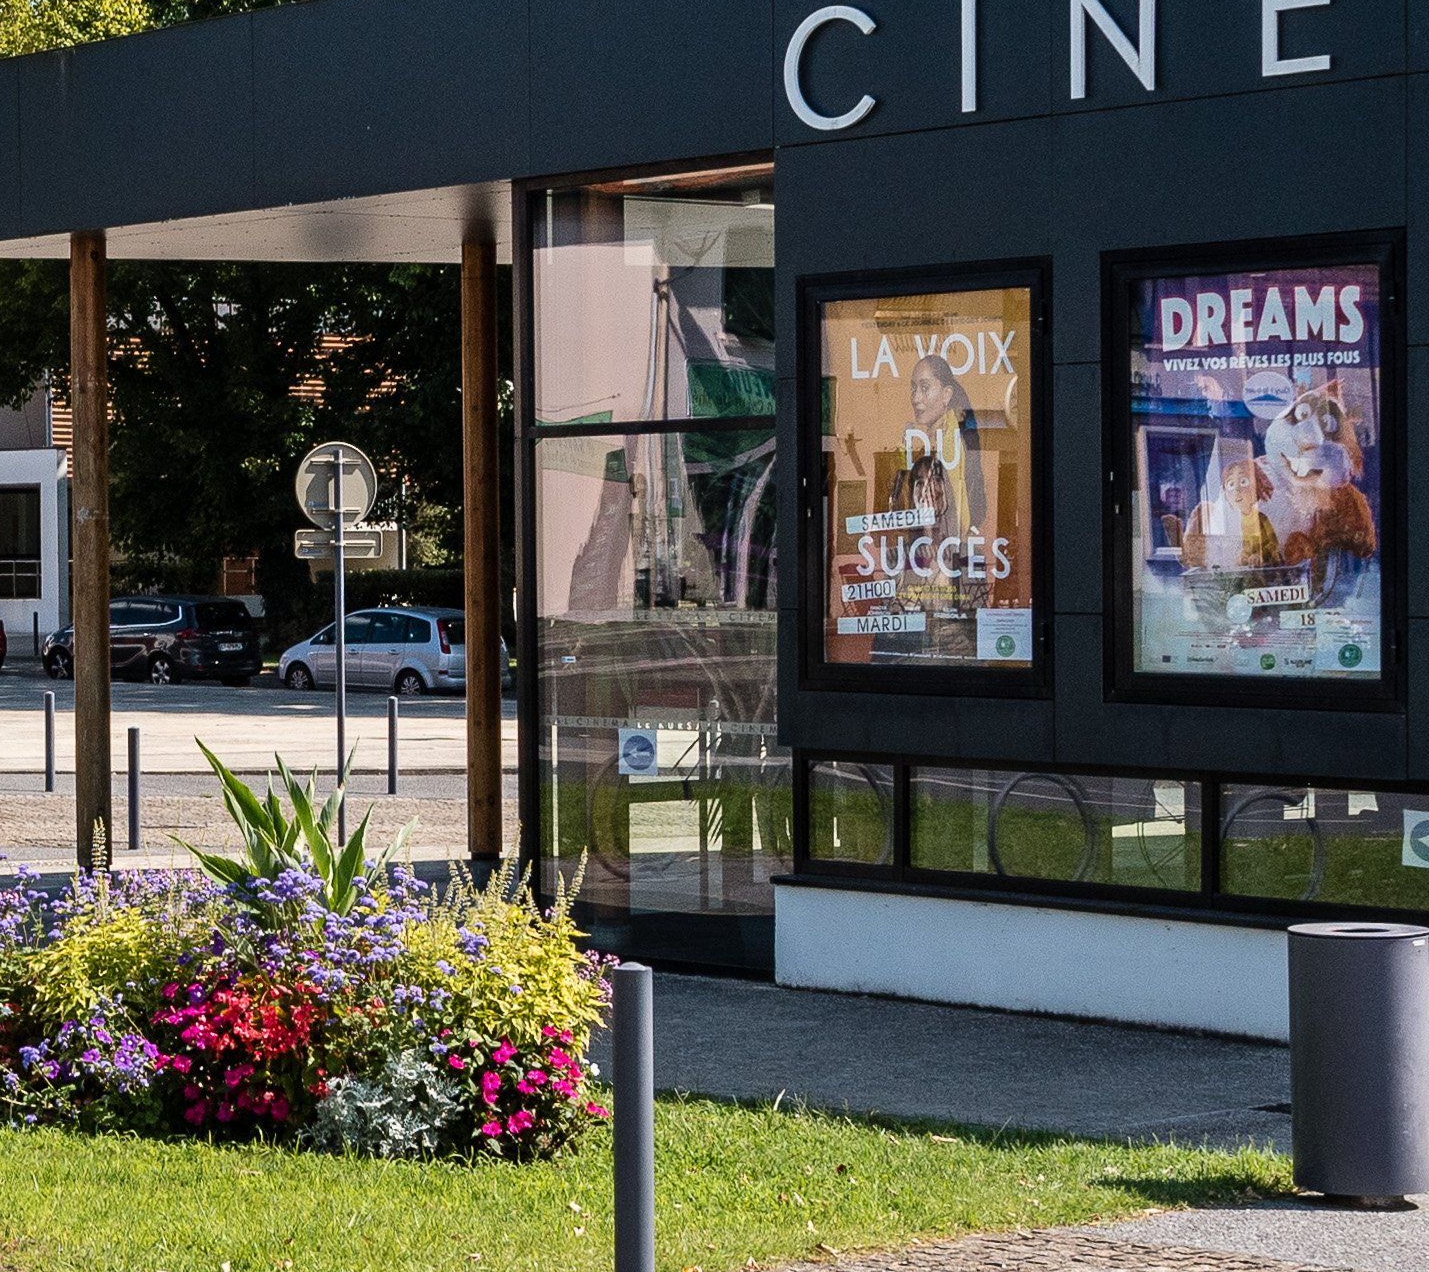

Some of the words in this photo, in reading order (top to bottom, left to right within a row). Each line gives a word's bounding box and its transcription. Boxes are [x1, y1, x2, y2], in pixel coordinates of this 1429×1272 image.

[1161, 285, 1364, 352] DREAMS
[850, 334, 900, 379] LA
[913, 331, 1016, 376] VOIX
[1163, 357, 1199, 372] VIVEZ
[1202, 356, 1228, 370] VOS
[1230, 352, 1269, 369] RÊVES
[1271, 354, 1291, 368] LES
[1293, 352, 1325, 366] PLUS
[1327, 350, 1361, 365] FOUS
[906, 428, 962, 471] DU
[862, 510, 922, 531] SAMEDI
[856, 526, 1012, 579] SUCCÈS
[847, 581, 892, 600] 21H00
[1247, 588, 1306, 605] SAMEDI
[857, 616, 908, 633] MARDI
